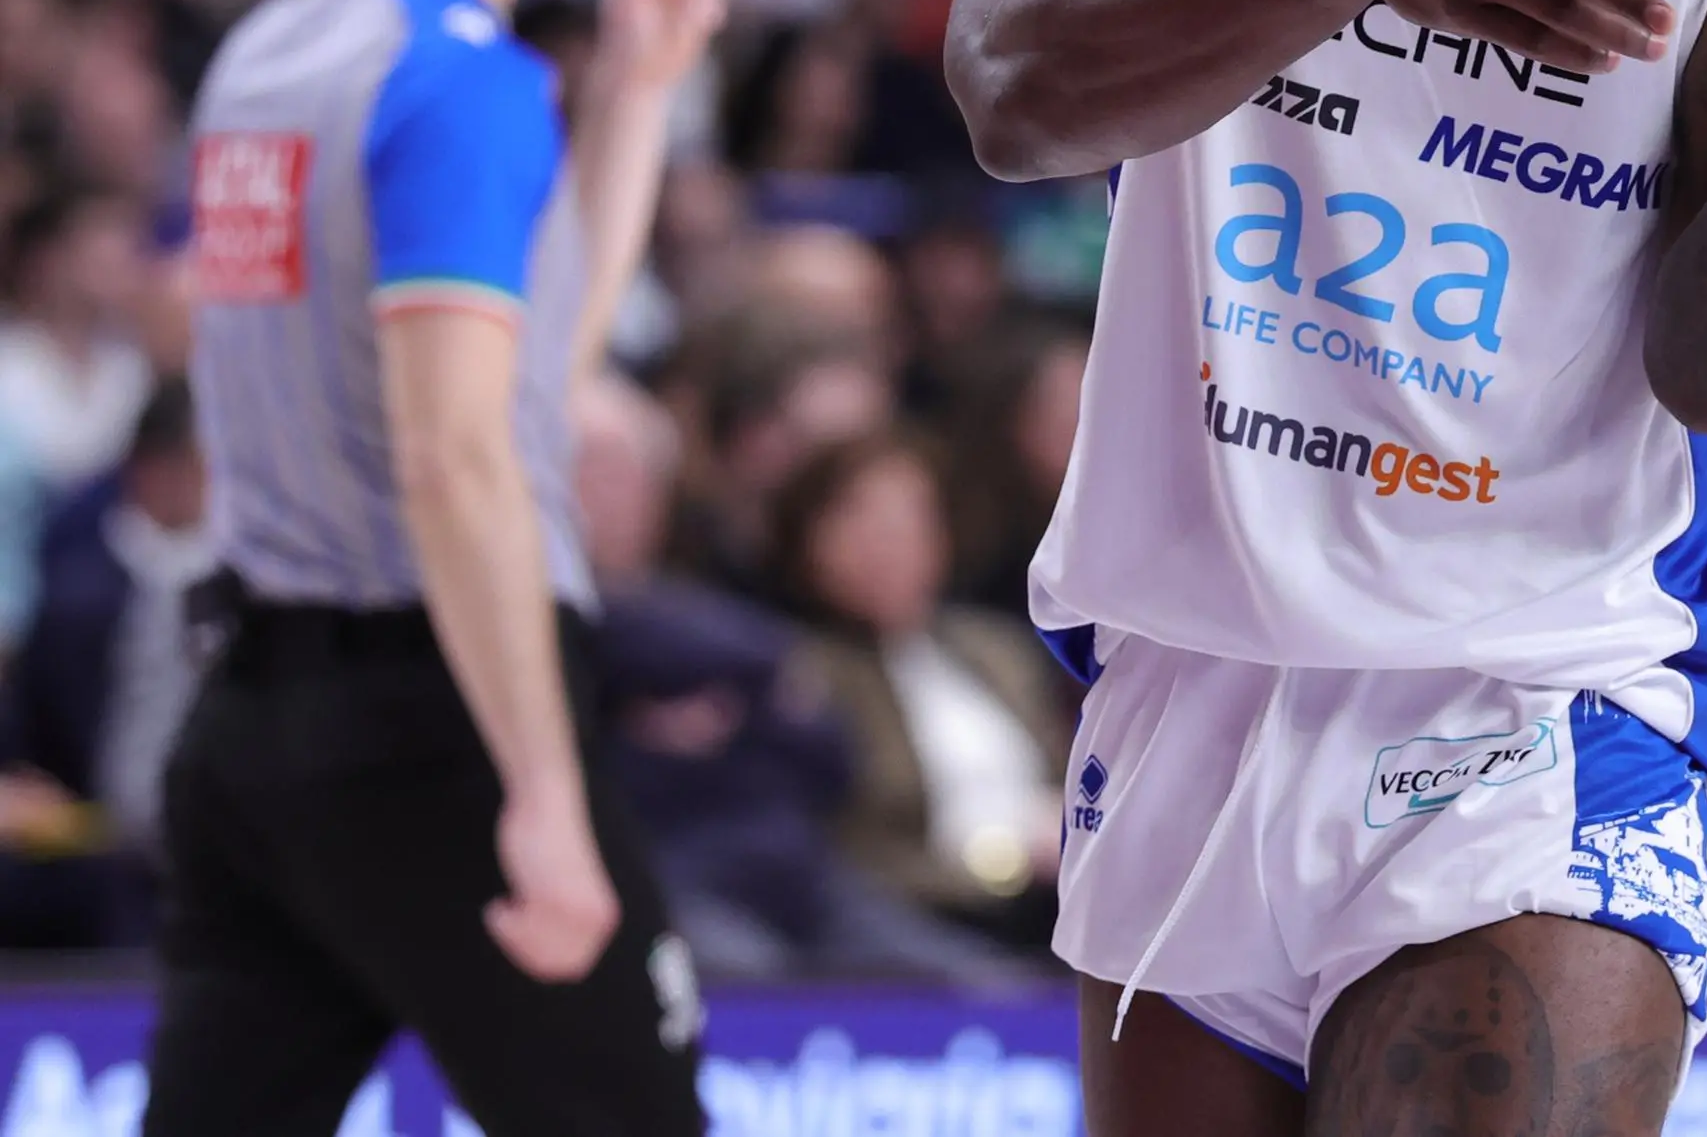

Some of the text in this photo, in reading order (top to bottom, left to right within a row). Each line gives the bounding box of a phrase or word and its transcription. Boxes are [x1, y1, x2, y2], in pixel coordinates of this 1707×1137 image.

[1252, 75, 1360, 136] zza
[1214, 163, 1511, 353] a2a
[1202, 296, 1494, 403] LIFE COMPANY
